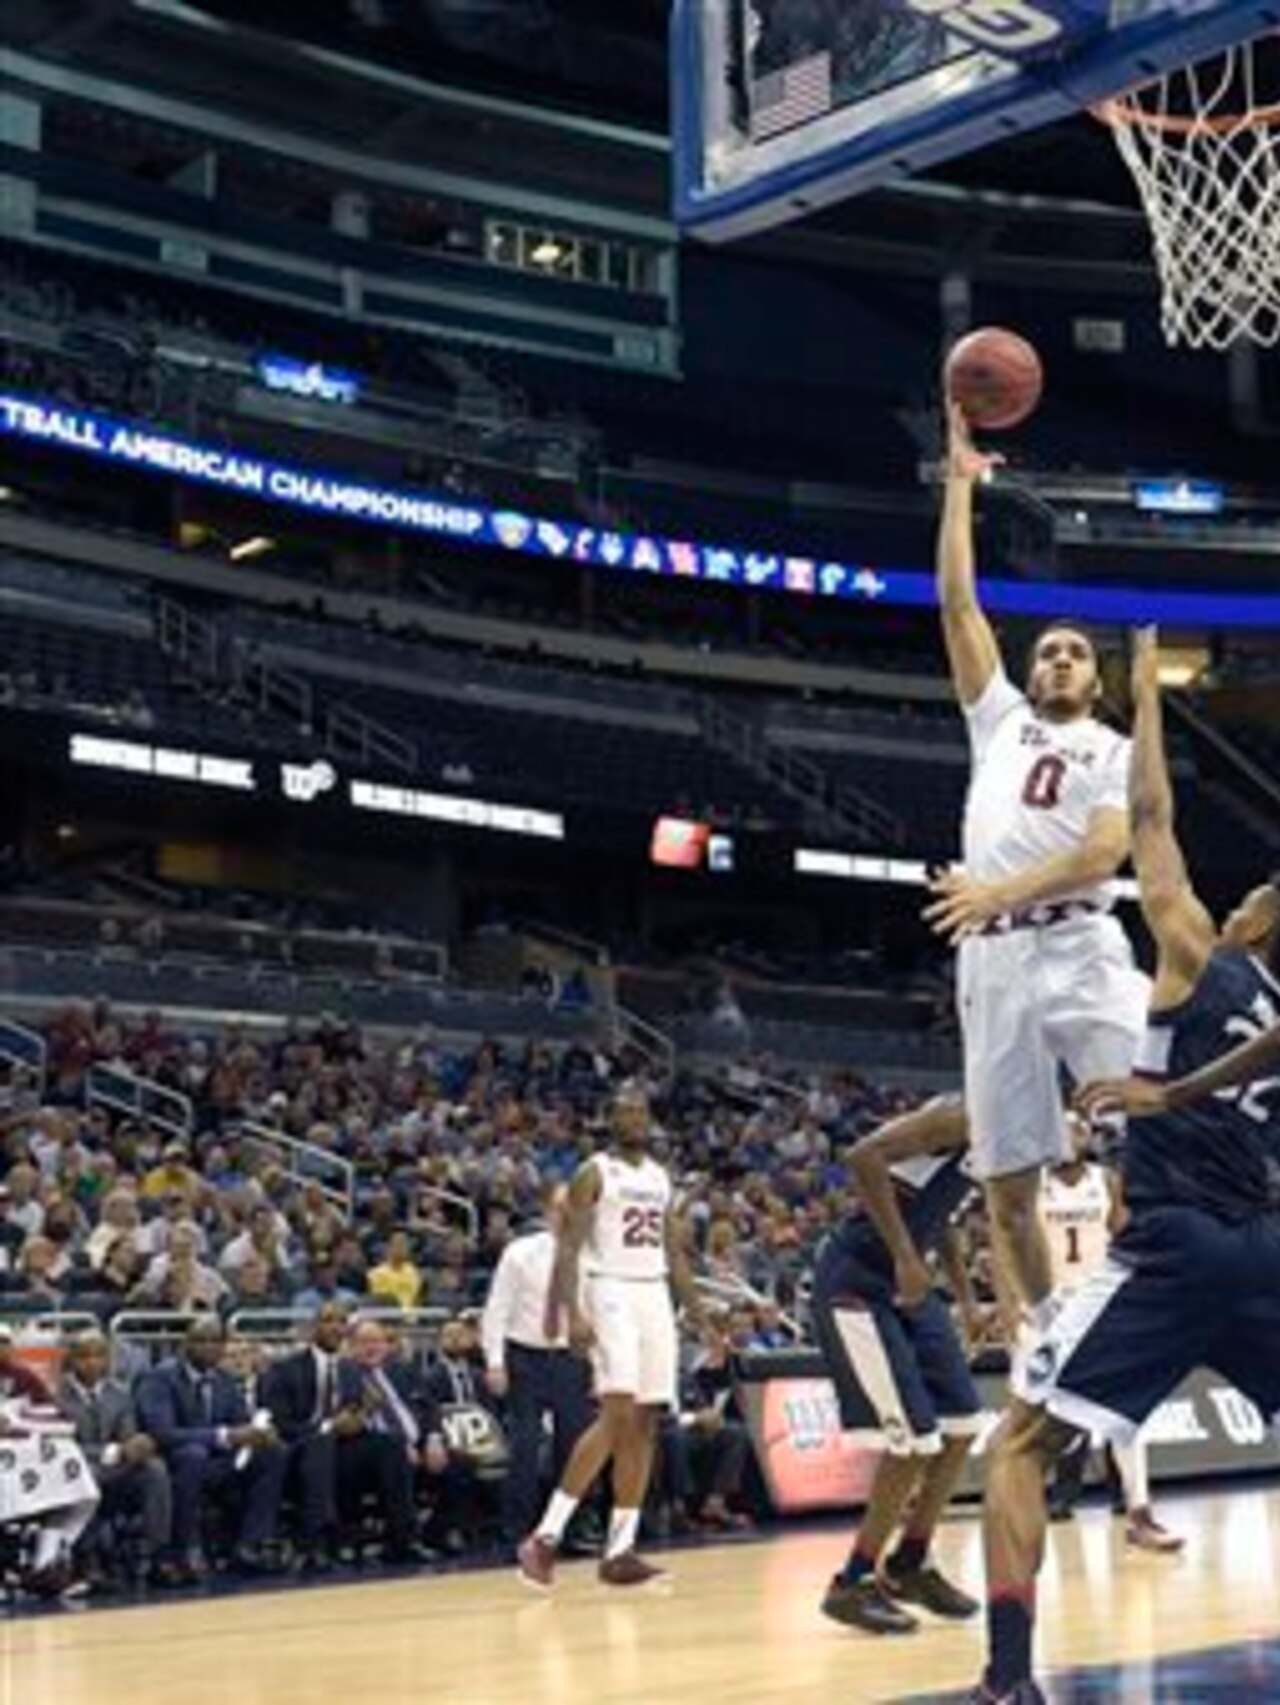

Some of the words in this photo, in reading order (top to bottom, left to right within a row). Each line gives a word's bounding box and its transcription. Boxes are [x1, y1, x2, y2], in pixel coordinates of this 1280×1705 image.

[110, 431, 262, 489] AMERICAN
[270, 472, 483, 533] CHAMPIONSHIP
[1021, 753, 1067, 811] 0
[622, 1205, 661, 1249] 25
[1065, 1226, 1082, 1264] 1
